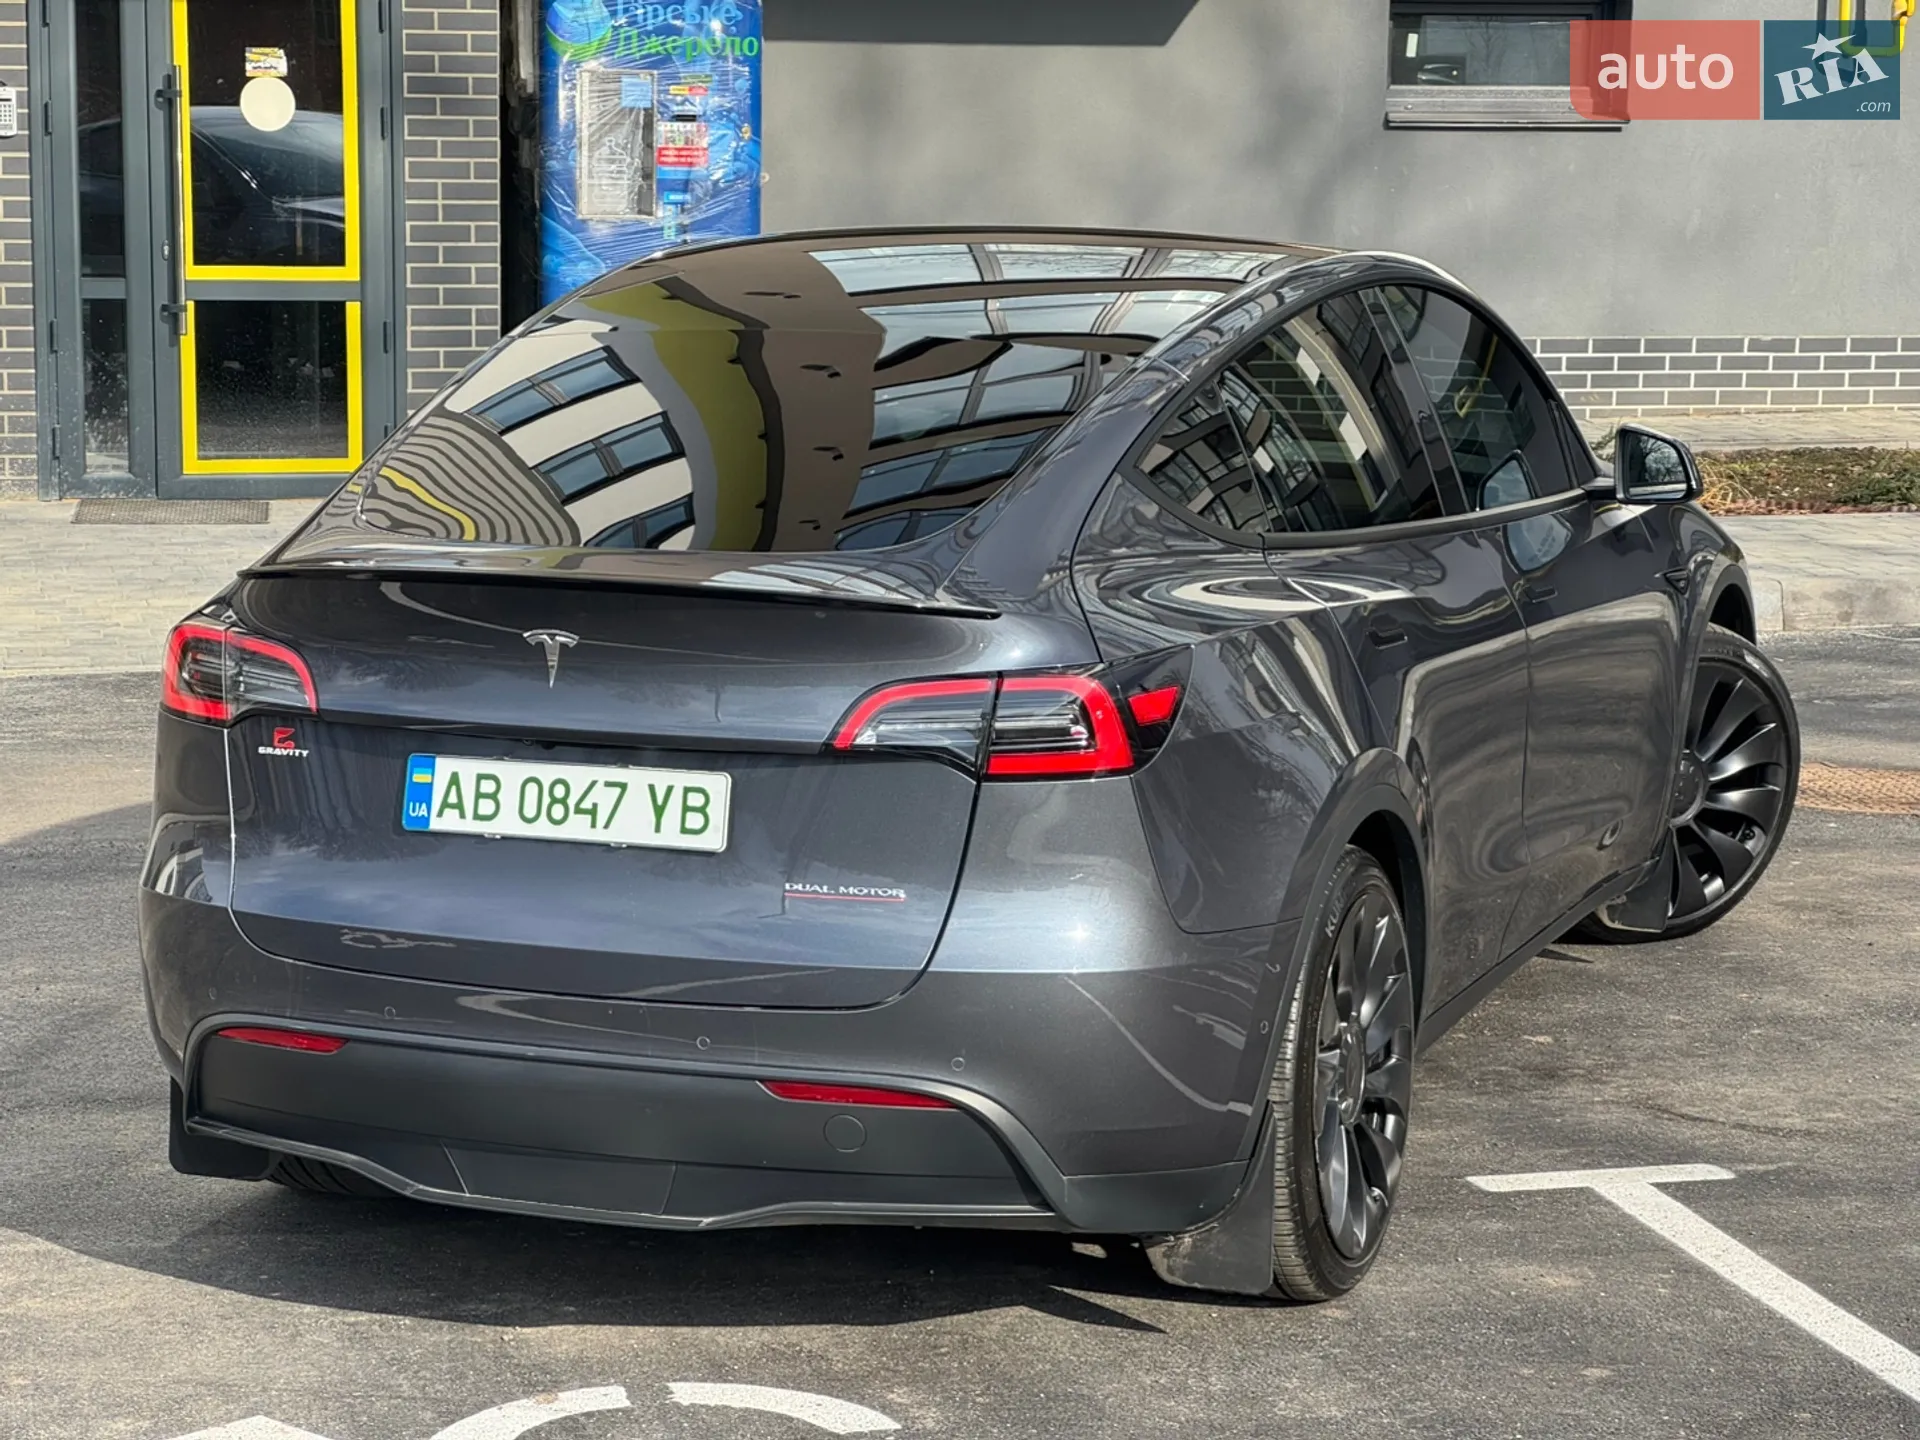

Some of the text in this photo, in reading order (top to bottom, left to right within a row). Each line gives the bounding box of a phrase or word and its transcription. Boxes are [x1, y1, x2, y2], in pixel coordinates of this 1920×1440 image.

[614, 27, 759, 62] Джерело
[258, 746, 310, 757] GRAVITY
[408, 801, 428, 818] UA
[436, 771, 711, 835] AB 0847 YB
[784, 882, 907, 899] DUAL MOTOR
